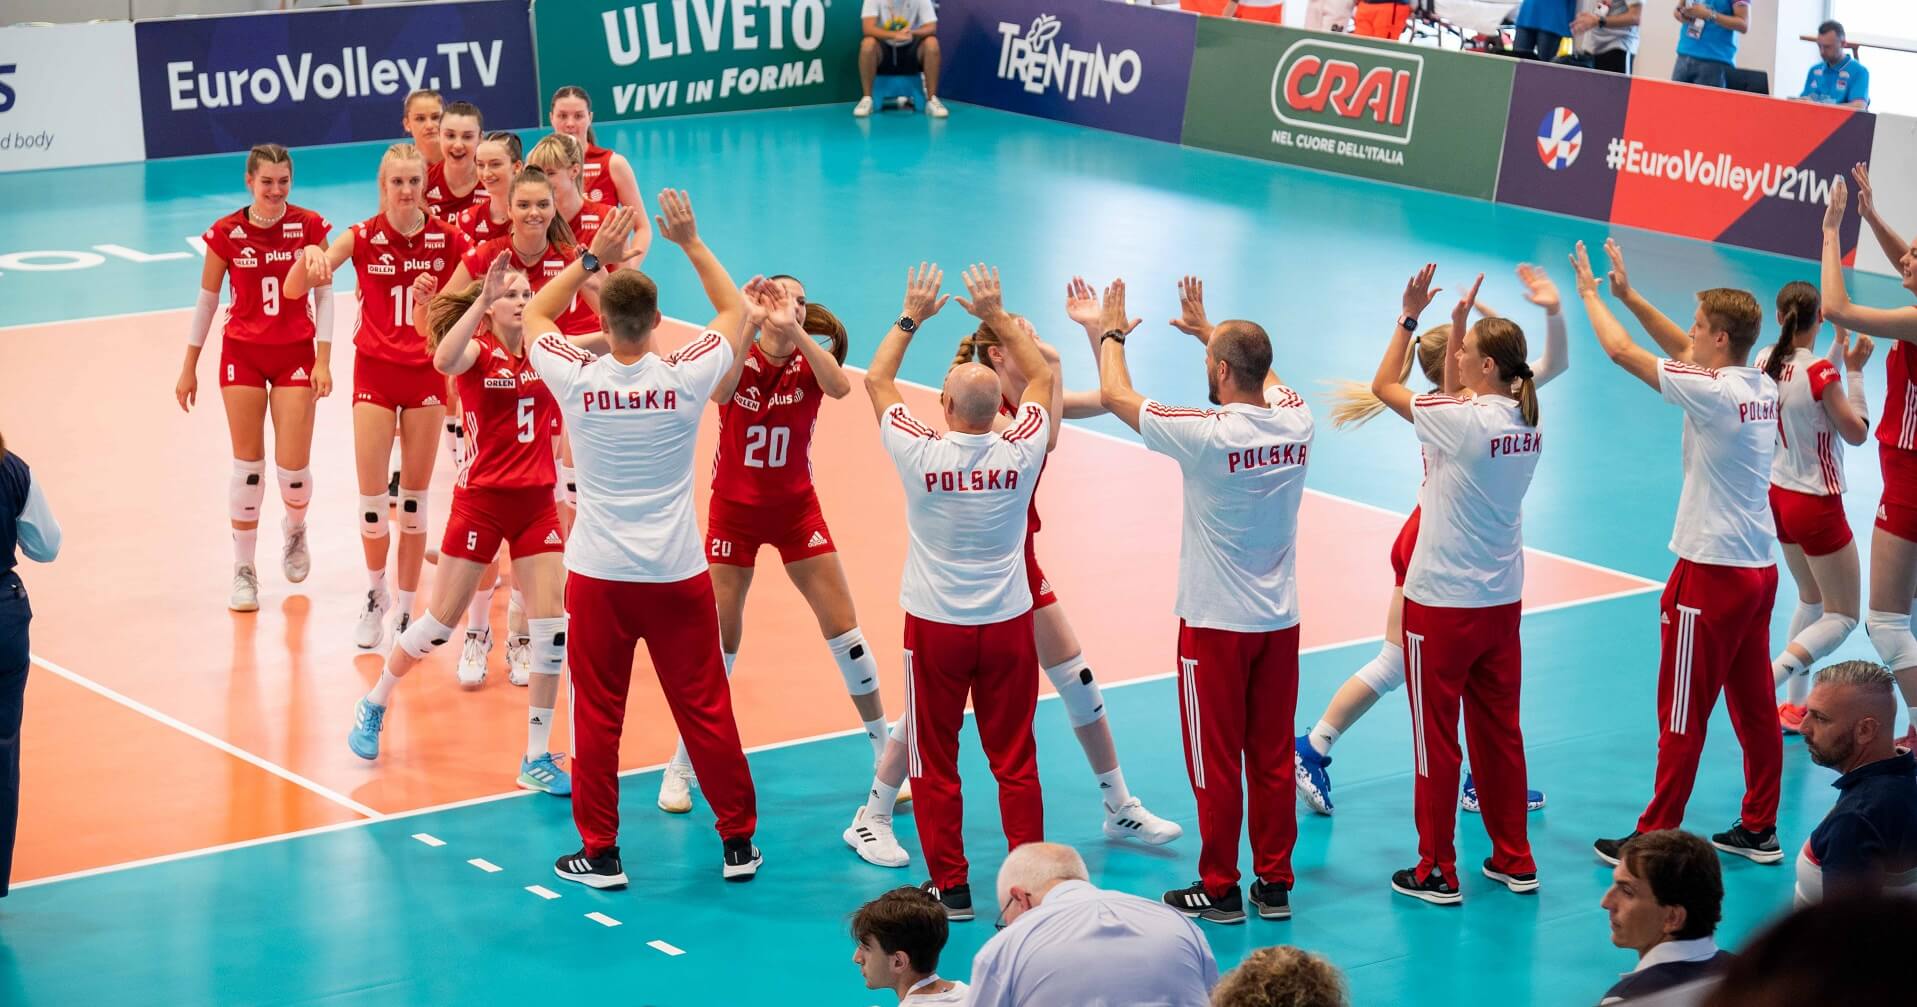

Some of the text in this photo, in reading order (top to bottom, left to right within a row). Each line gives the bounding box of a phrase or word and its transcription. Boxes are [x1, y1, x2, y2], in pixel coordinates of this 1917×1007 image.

[602, 0, 826, 66] ULIVETO
[167, 40, 503, 111] EuroVolley.TV
[997, 21, 1142, 104] TRENTINO
[612, 58, 825, 115] VIVI IN FORMA
[1283, 54, 1411, 126] CRAI
[14, 130, 55, 151] body
[1271, 130, 1404, 165] NEL CUORE DELL'ITALIA
[265, 250, 292, 264] plus
[403, 258, 431, 272] plus
[261, 276, 280, 316] 9
[486, 379, 514, 387] ORLEN
[583, 389, 677, 413] POLSKA
[768, 392, 793, 410] plus
[517, 397, 535, 443] 5
[744, 424, 791, 469] 20
[1228, 444, 1307, 473] POLSKA
[1490, 432, 1542, 458] POLSK
[925, 469, 1019, 492] POLSKA
[467, 530, 478, 551] 5
[711, 538, 732, 557] 20
